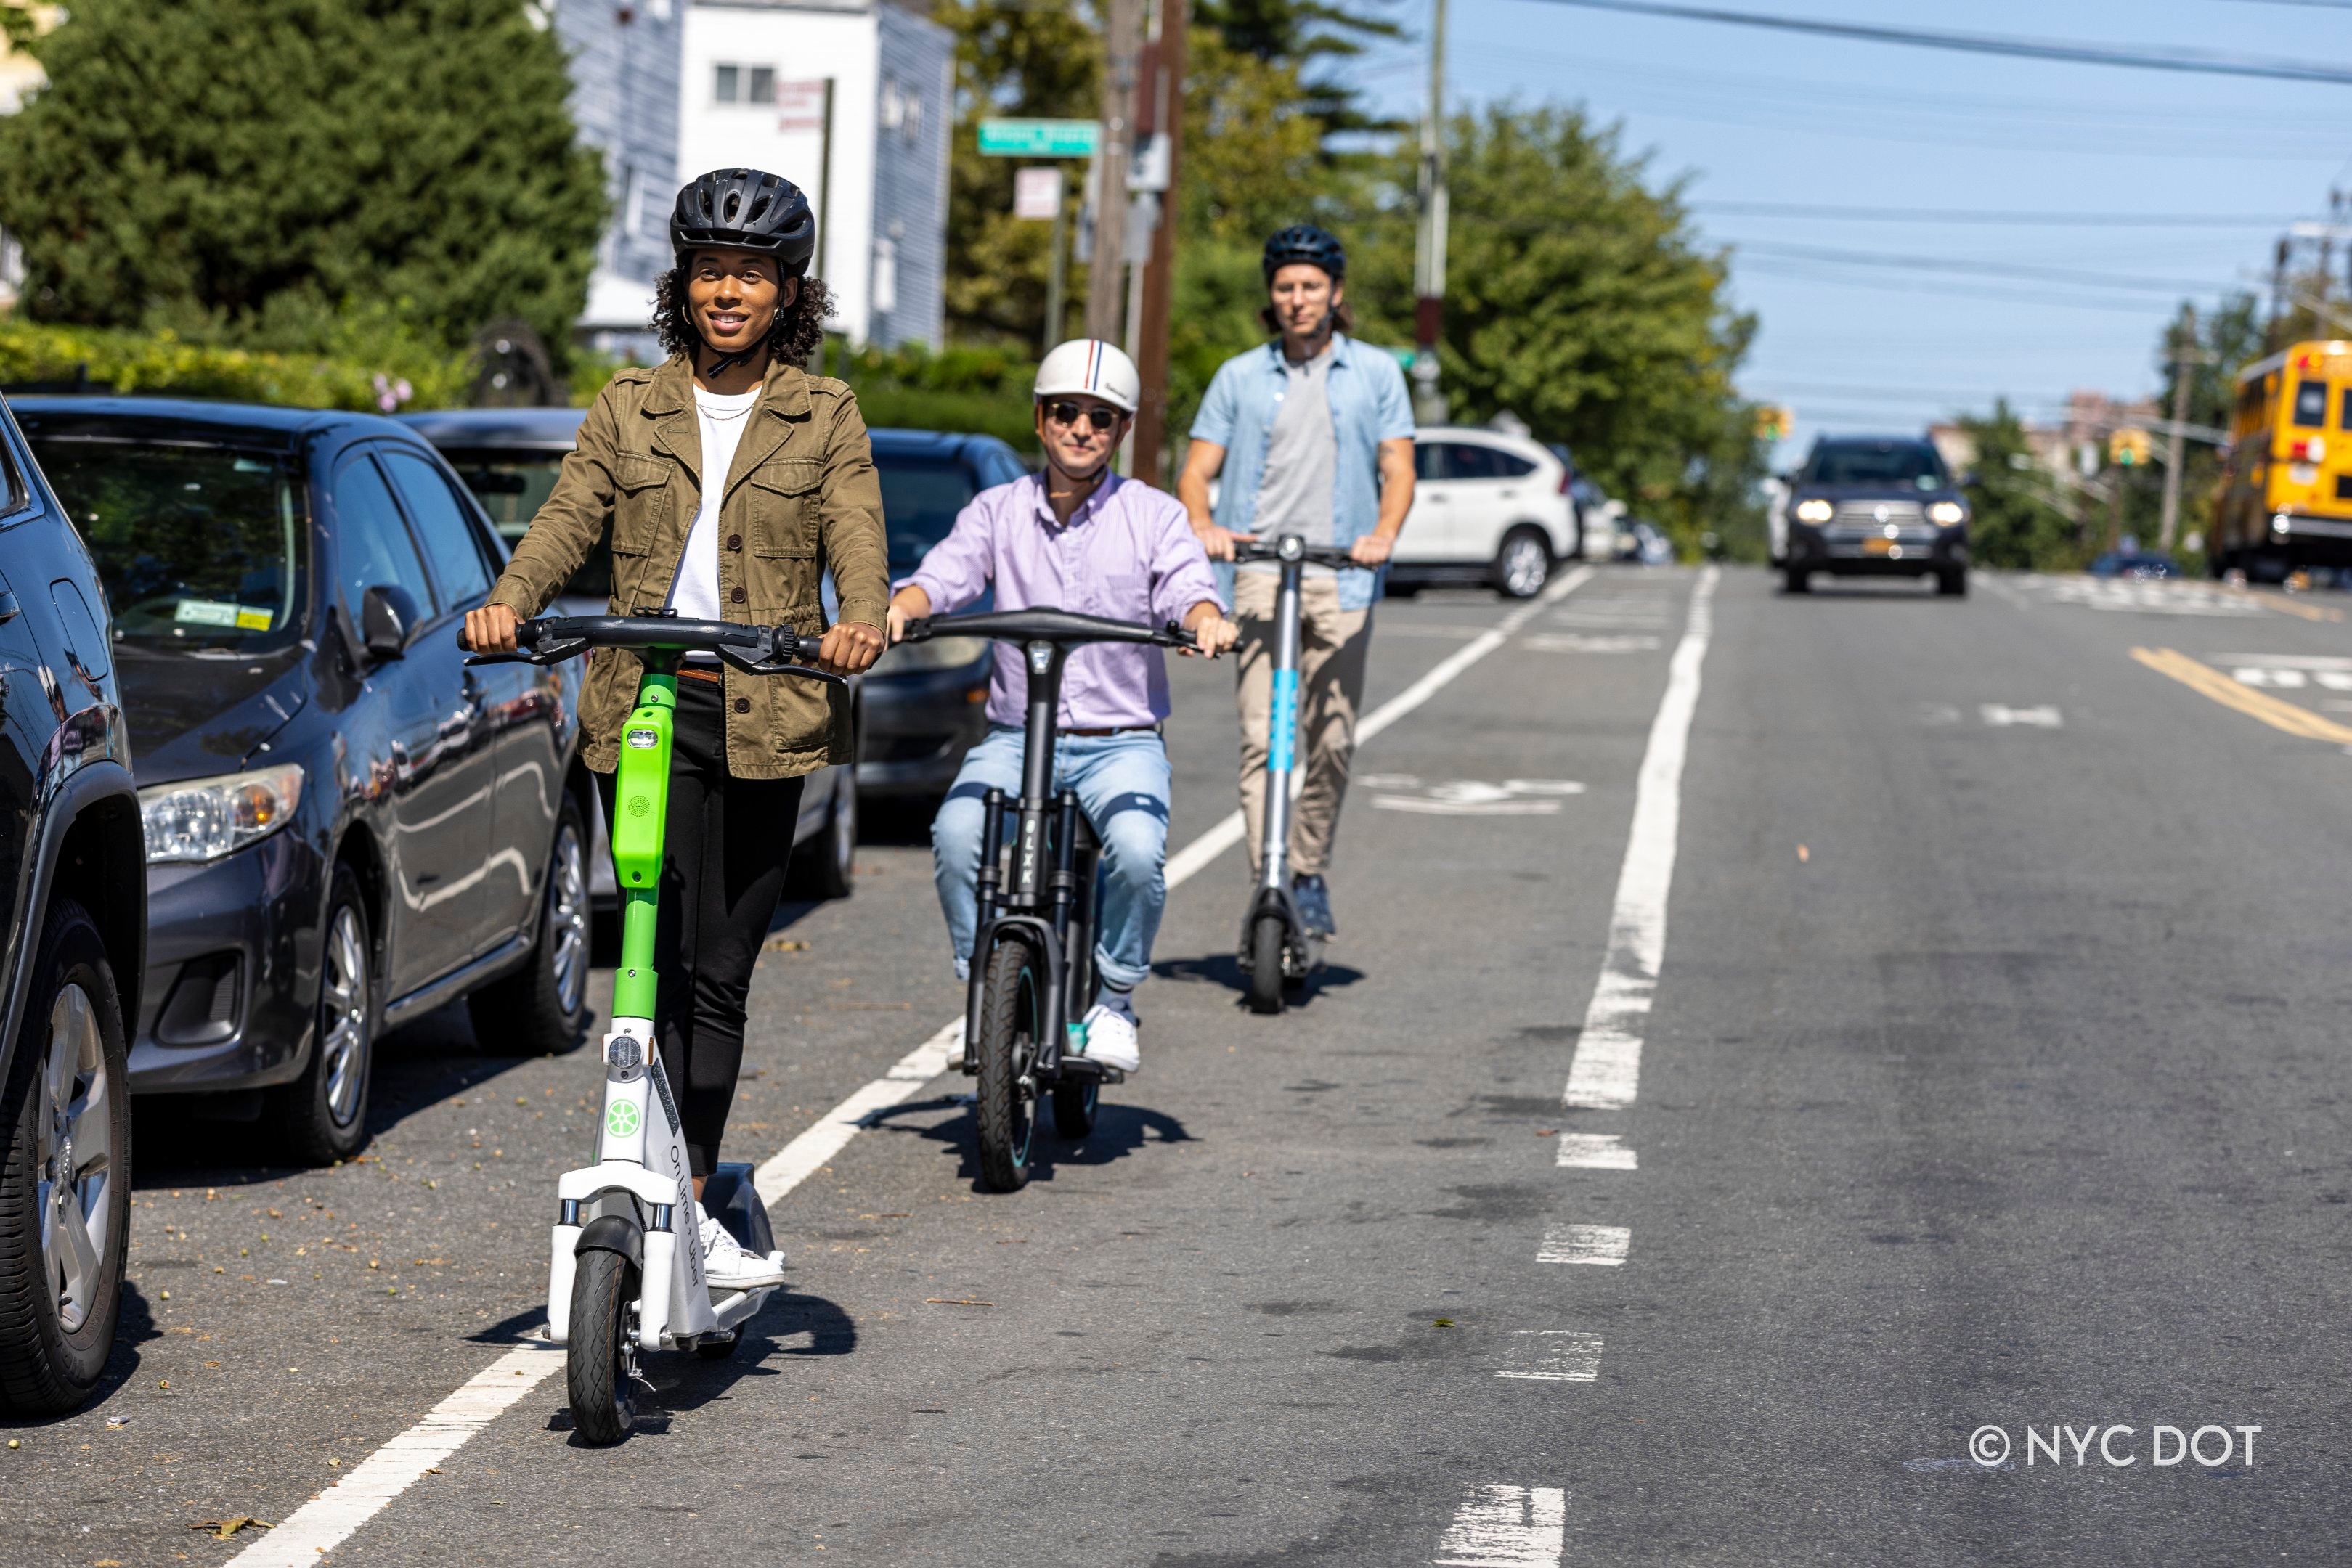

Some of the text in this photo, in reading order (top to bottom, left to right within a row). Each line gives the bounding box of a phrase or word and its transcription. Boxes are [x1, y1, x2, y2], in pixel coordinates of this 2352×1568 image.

[670, 1145, 681, 1177] On
[677, 1175, 691, 1225] Lime
[688, 1238, 699, 1287] Uber
